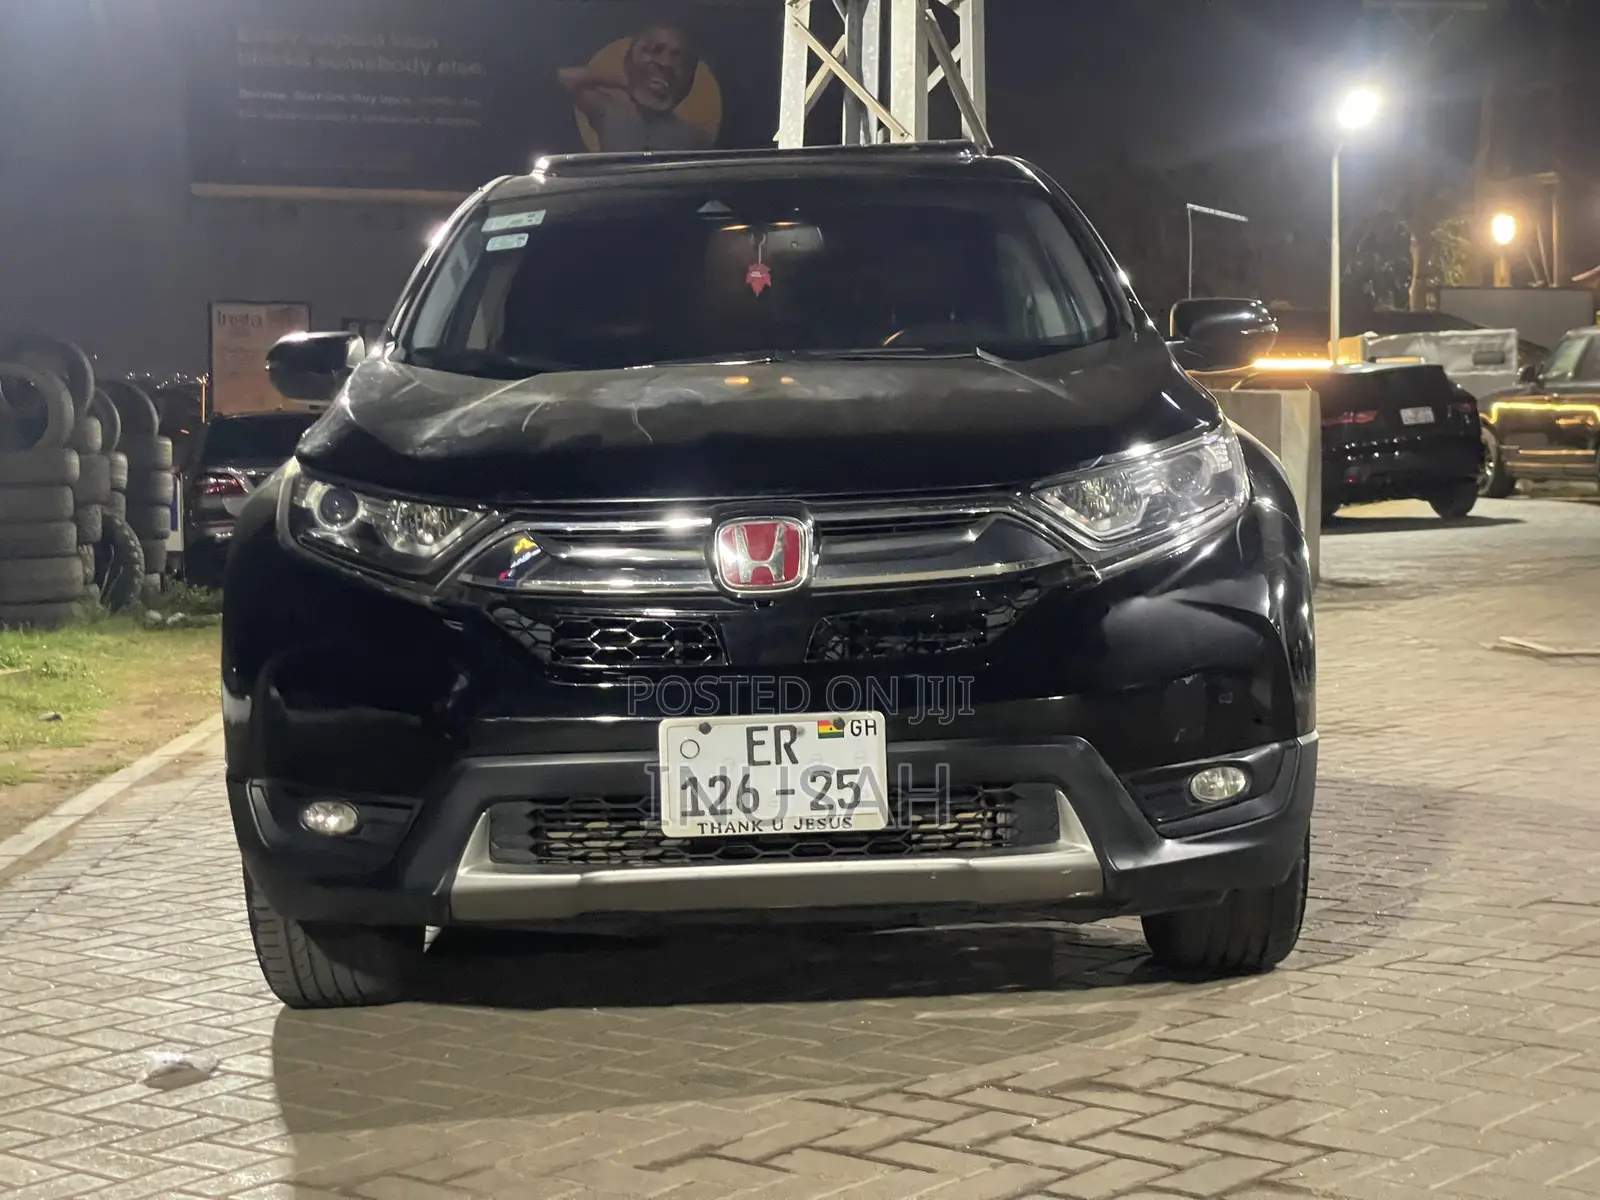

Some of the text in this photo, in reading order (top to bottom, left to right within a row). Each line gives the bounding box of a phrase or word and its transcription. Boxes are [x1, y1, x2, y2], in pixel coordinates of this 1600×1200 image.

[850, 718, 878, 737] GH
[746, 724, 798, 767] ER
[697, 815, 853, 836] THANK U JESUS
